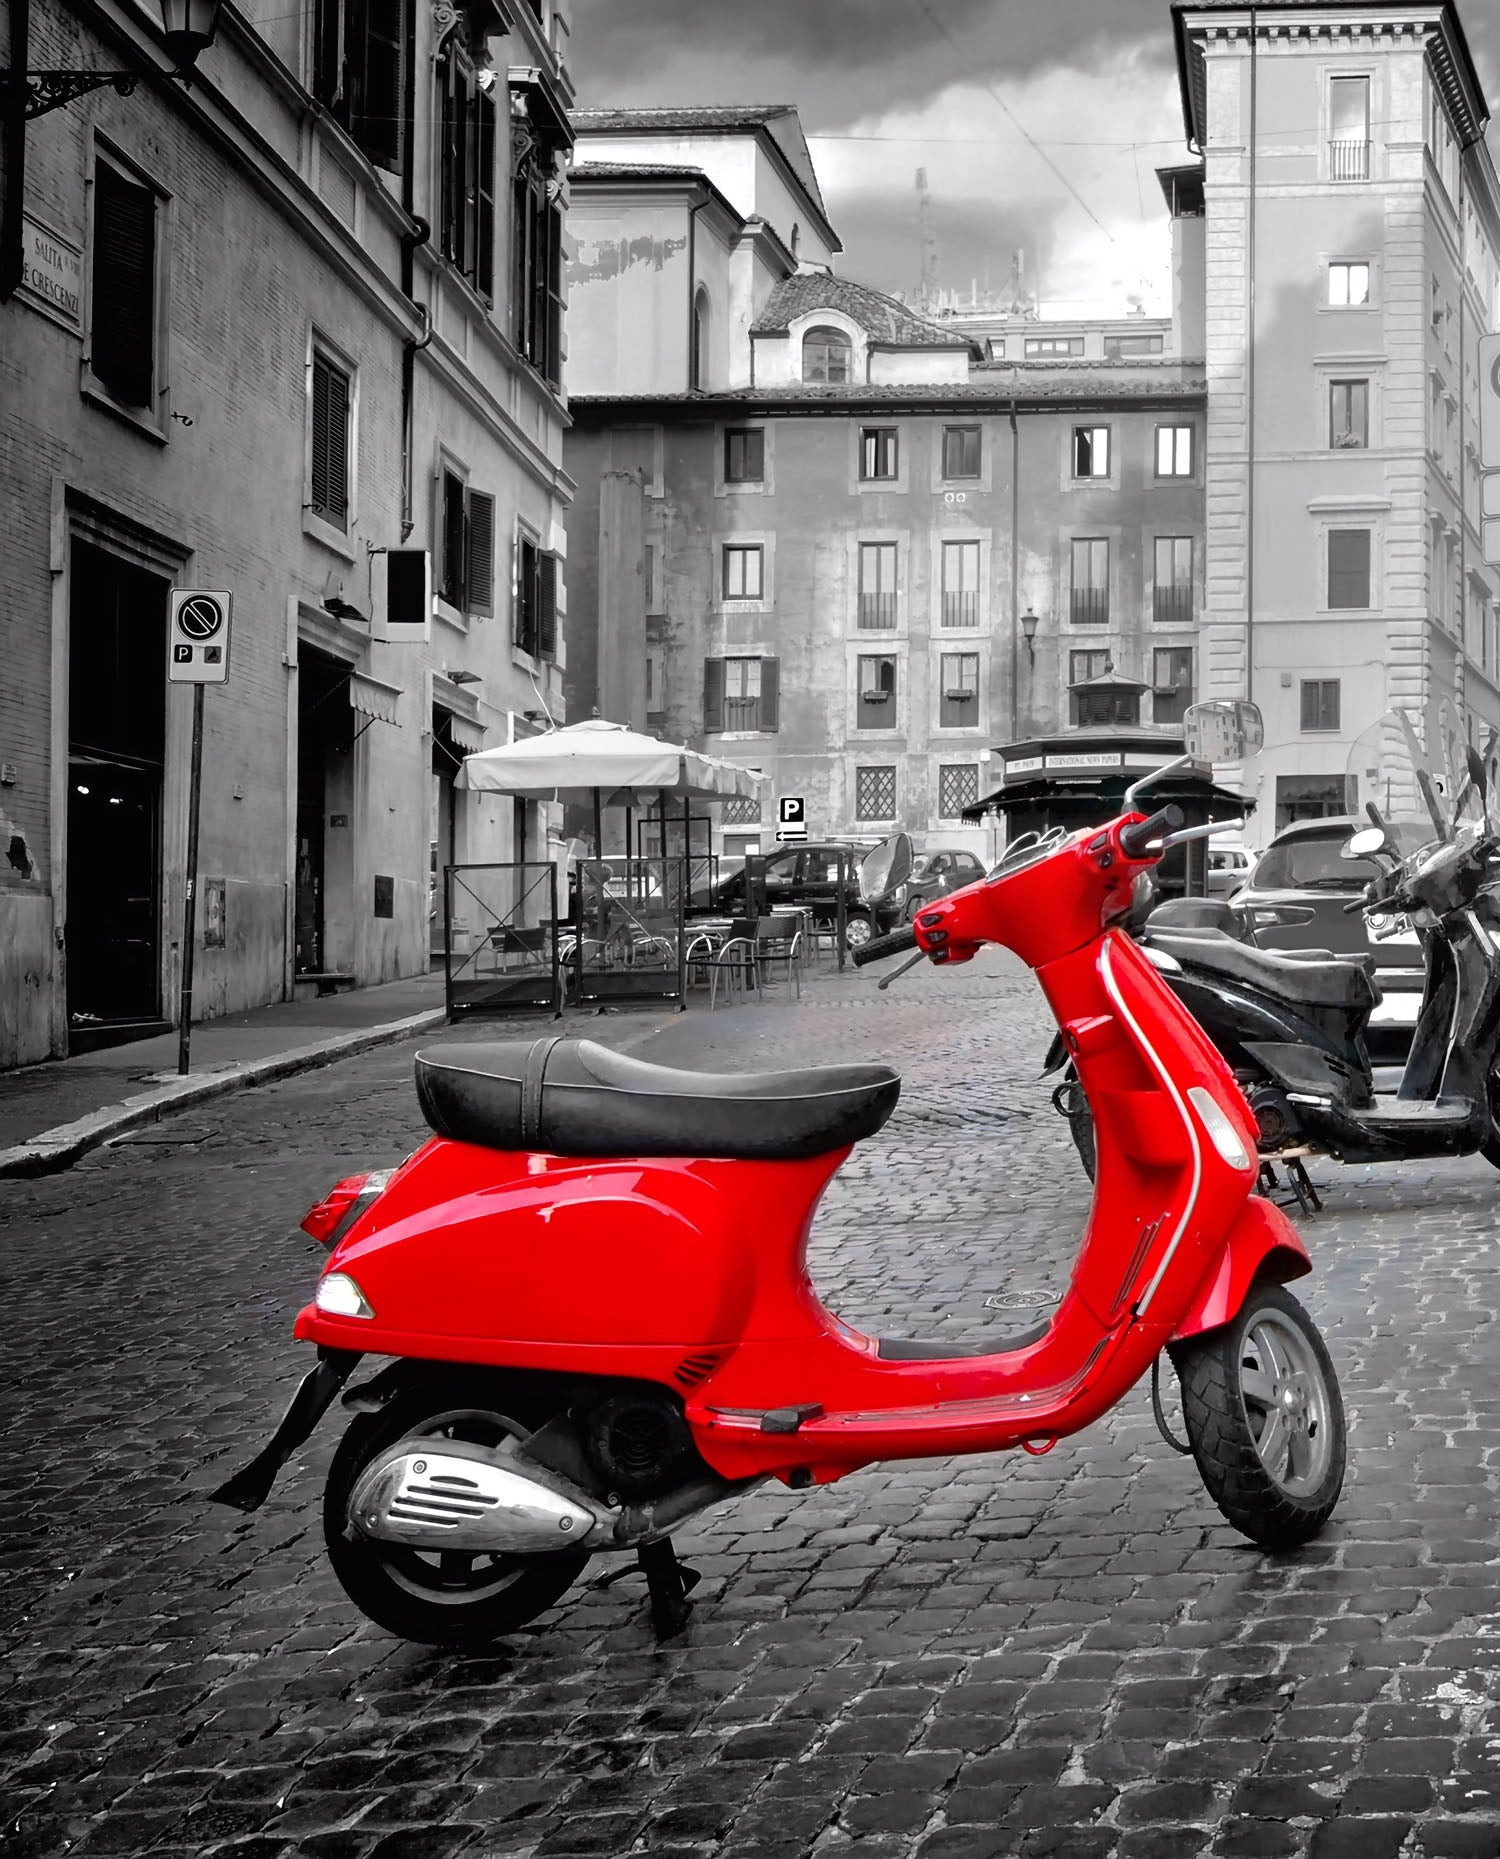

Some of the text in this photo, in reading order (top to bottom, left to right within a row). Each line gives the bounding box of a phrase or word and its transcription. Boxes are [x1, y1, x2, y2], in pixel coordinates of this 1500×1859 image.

[35, 238, 63, 272] SALITA
[31, 268, 79, 315] CRESCENZI
[179, 647, 189, 660] P
[785, 800, 800, 820] P
